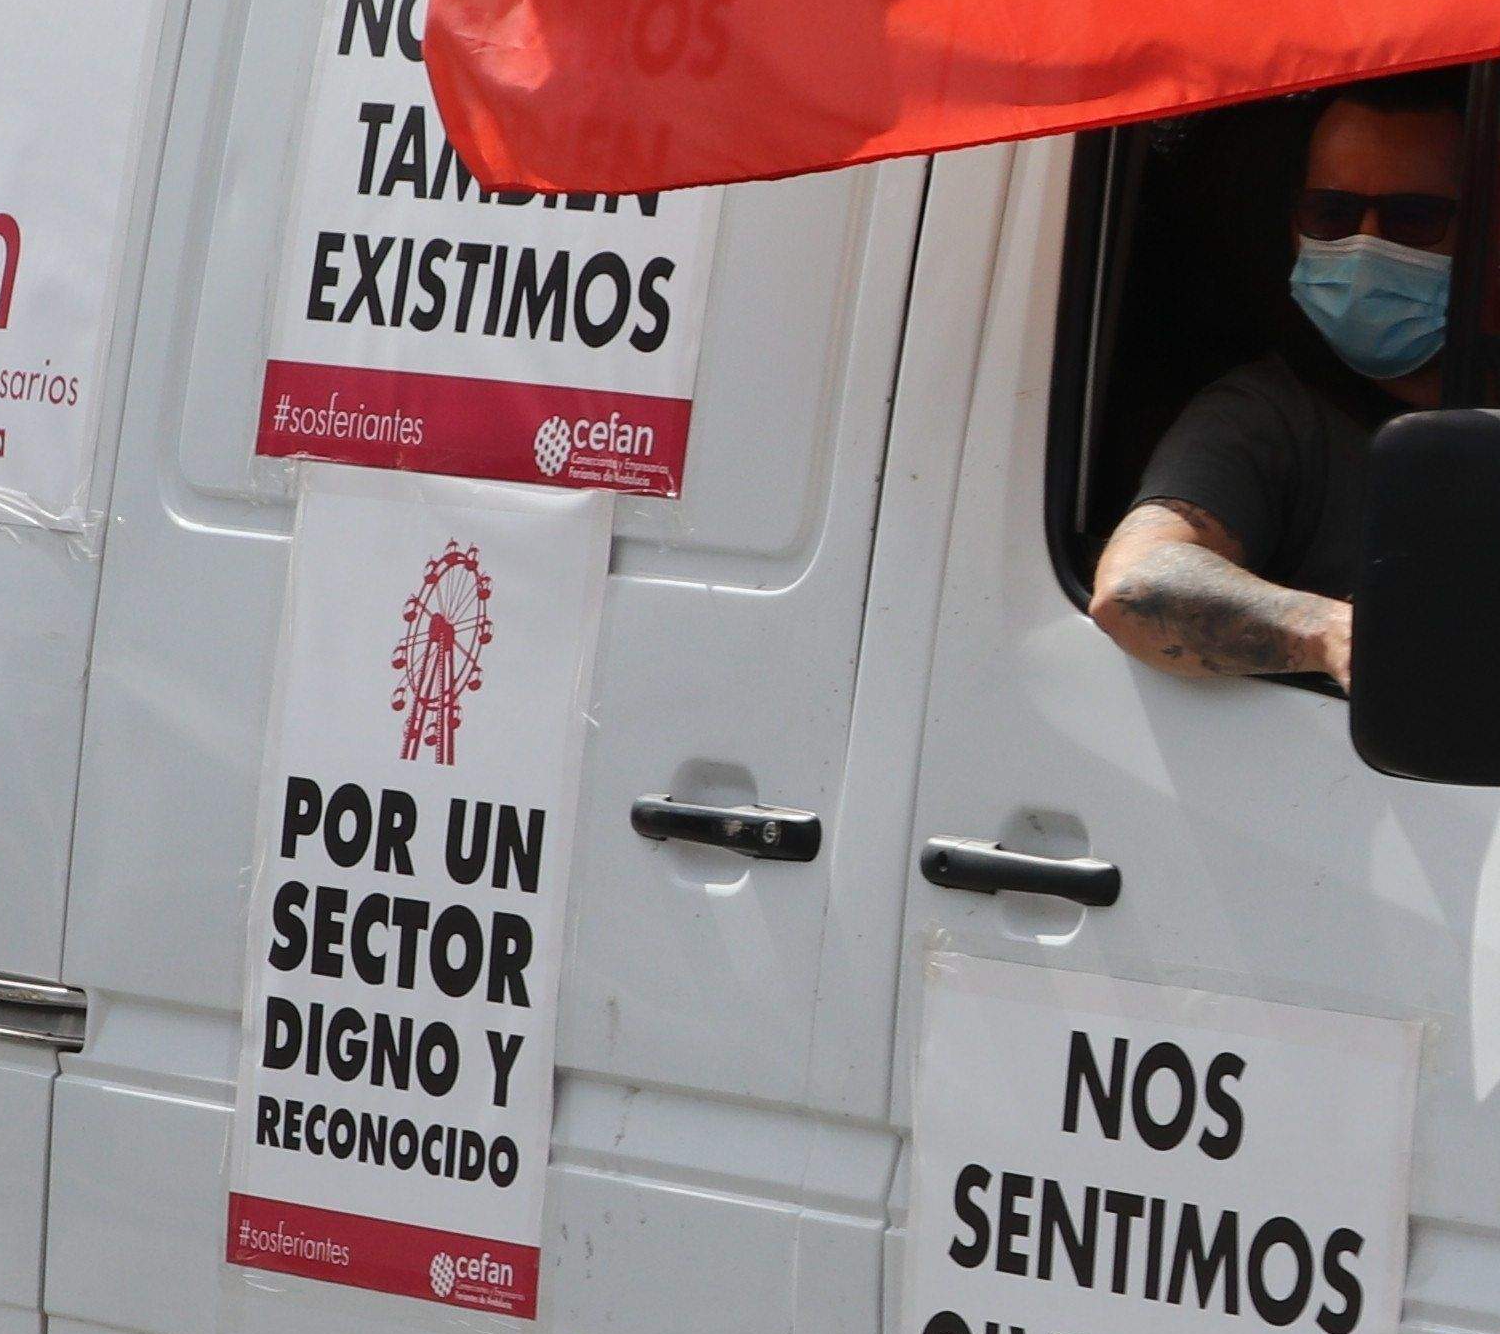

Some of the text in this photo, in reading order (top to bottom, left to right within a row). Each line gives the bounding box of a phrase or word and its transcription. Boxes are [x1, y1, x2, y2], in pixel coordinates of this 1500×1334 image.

[306, 231, 676, 354] EXISTIMOS
[274, 392, 424, 446] #sosferiantes
[573, 412, 654, 456] cefan
[280, 774, 547, 895] POR UN
[268, 880, 533, 1008] SECTOR
[261, 995, 526, 1108] DIGNO Y
[1062, 1029, 1248, 1161] NOS
[256, 1094, 520, 1189] RECONOCIDO
[238, 1218, 350, 1268] #sosferiantes
[456, 1251, 514, 1287] cefan
